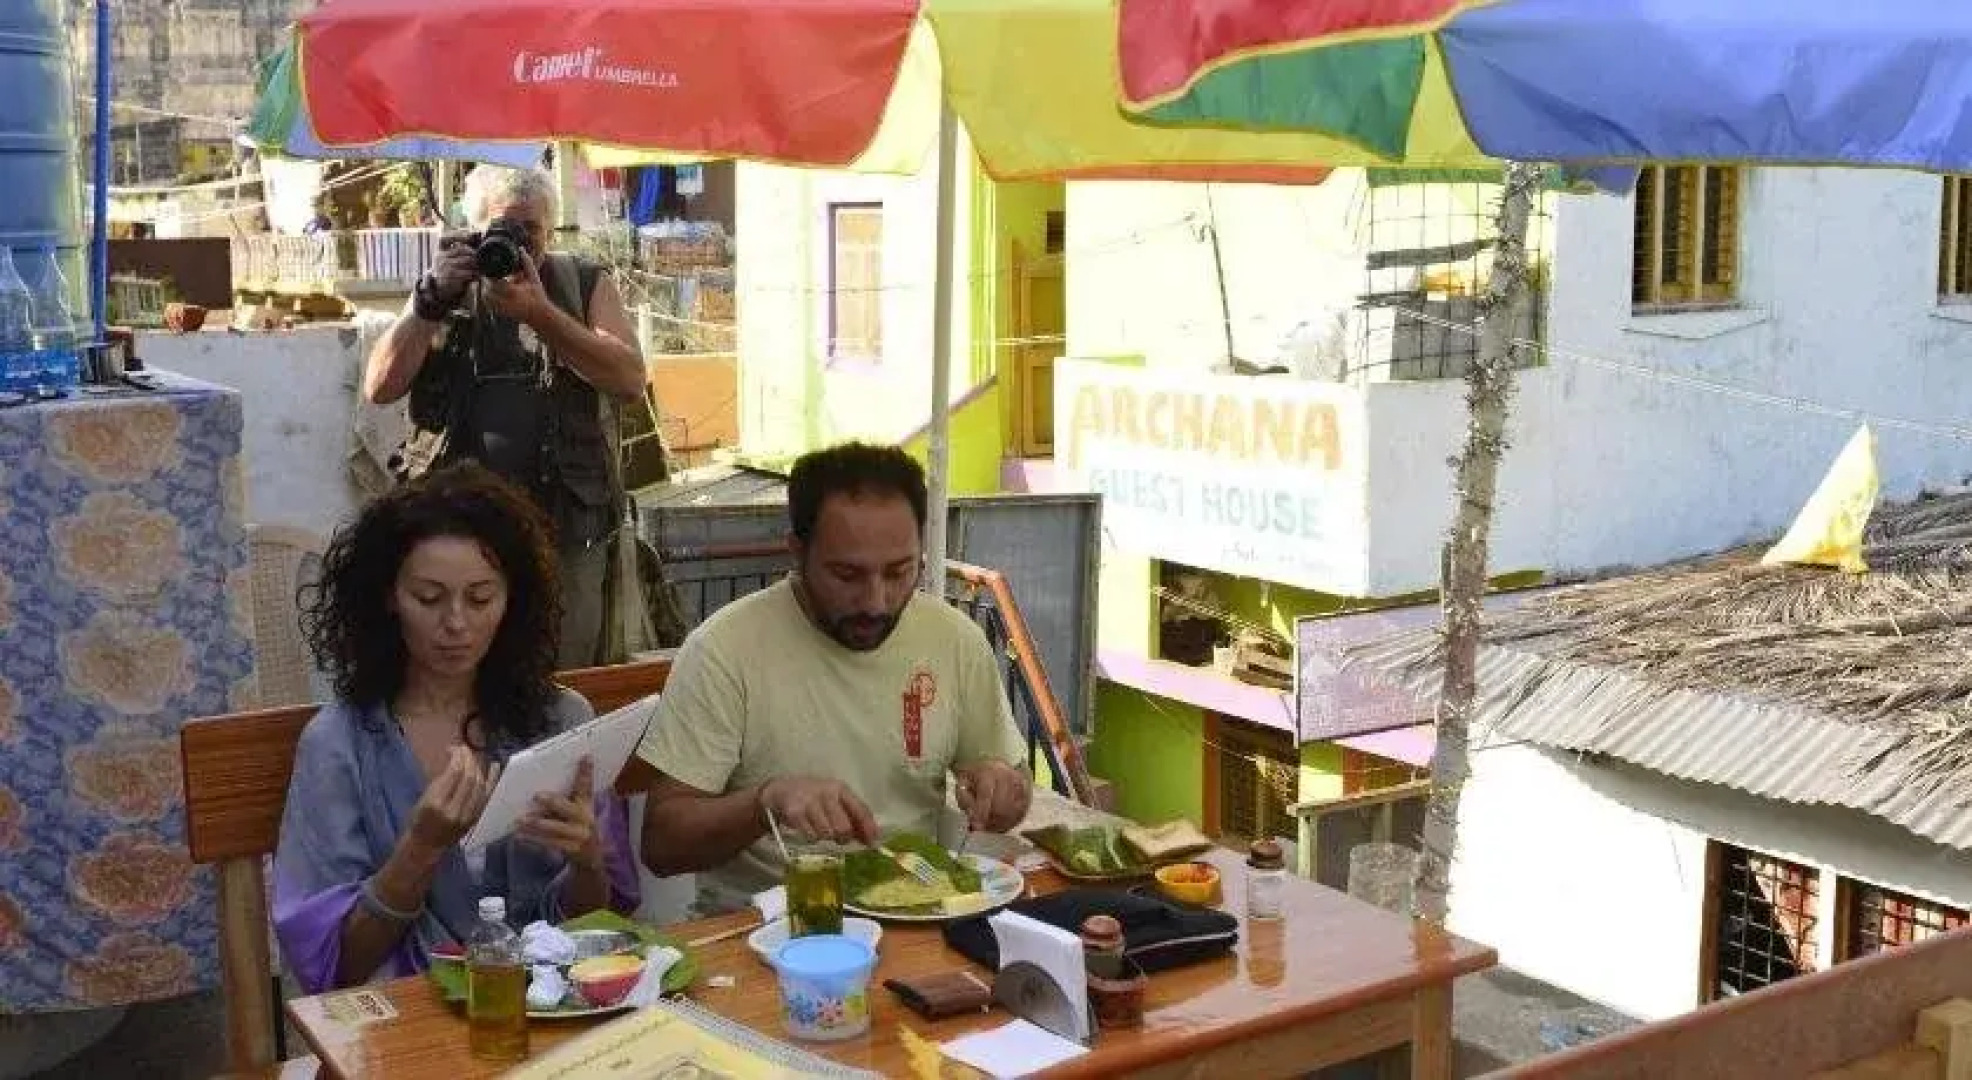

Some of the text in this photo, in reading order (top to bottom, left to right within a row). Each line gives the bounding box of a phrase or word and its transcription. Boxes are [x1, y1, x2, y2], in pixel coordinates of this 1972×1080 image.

[595, 65, 679, 87] UMBRELLA
[1068, 383, 1343, 470] ARCHANA
[1089, 469, 1325, 541] GUEST HOUSE
